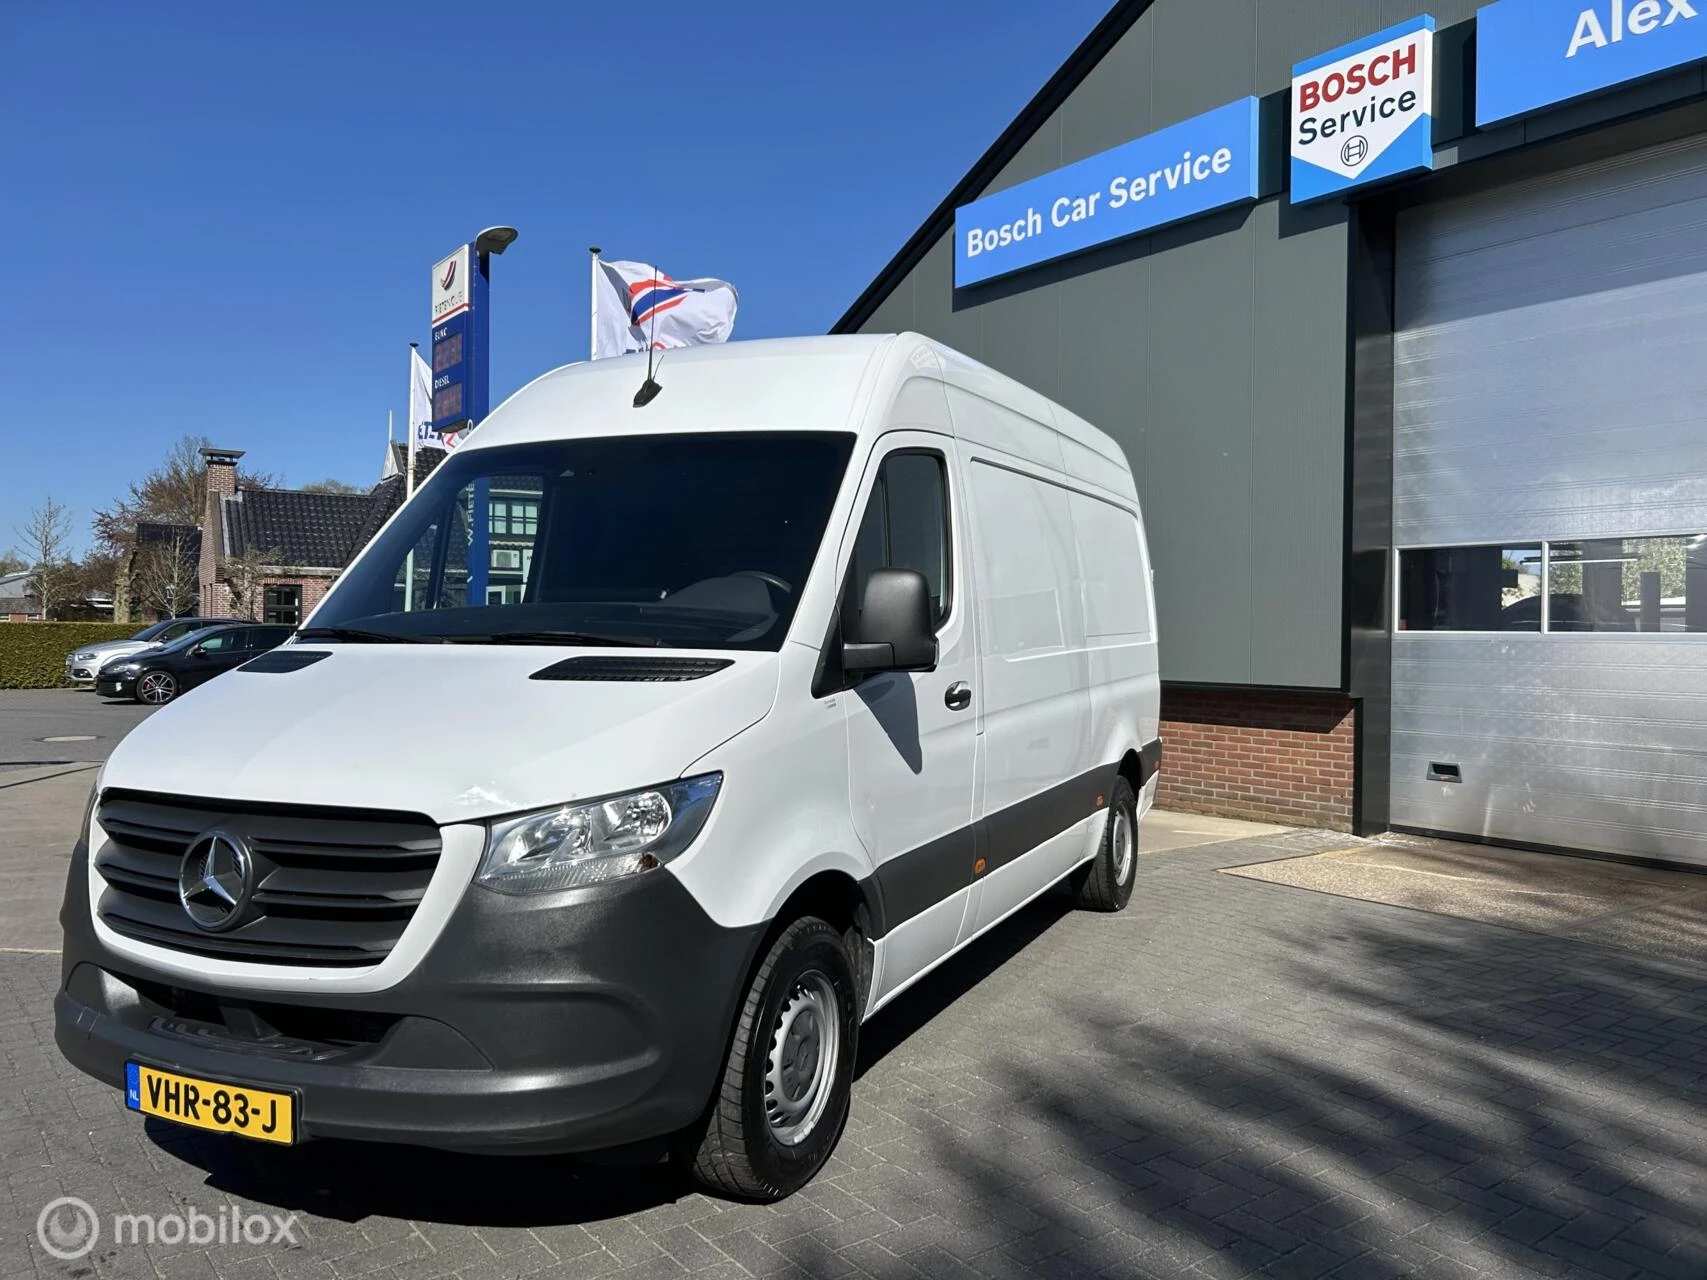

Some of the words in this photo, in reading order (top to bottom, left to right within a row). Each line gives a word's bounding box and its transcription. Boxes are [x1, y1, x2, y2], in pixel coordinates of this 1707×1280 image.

[1565, 0, 1699, 59] Alex
[1299, 43, 1416, 113] BOSCH
[1297, 88, 1417, 146] Service
[966, 207, 1042, 258] Bosch
[1051, 190, 1101, 228] Car
[1108, 147, 1232, 208] Service
[434, 374, 450, 389] DIESEL
[129, 1088, 140, 1102] NL
[146, 1074, 277, 1134] VHR-83-J
